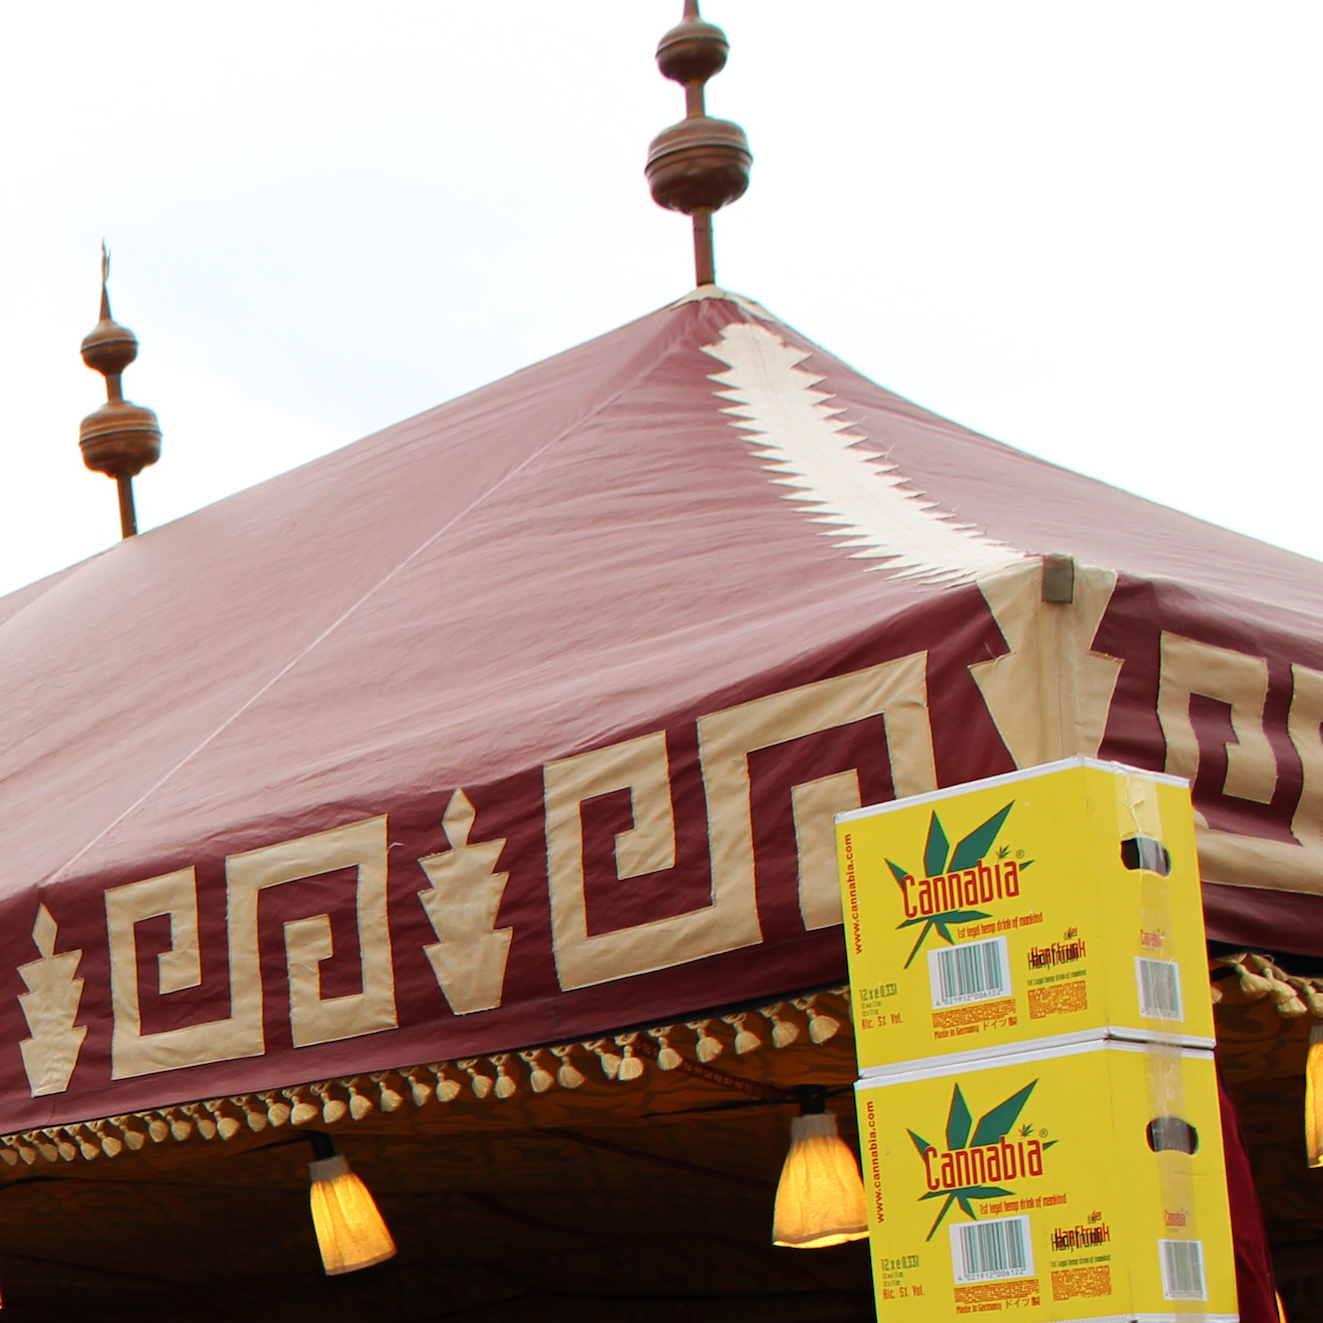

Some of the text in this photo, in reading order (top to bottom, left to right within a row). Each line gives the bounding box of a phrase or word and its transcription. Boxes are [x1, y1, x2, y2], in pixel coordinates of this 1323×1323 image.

[845, 833, 863, 955] www.cannabia.com
[902, 858, 1020, 919] Cannabia
[867, 1101, 884, 1223] www.cannabia.com
[925, 1136, 1043, 1191] Cannabia
[990, 1202, 1003, 1215] legal
[1004, 1199, 1018, 1212] hemp
[1020, 1197, 1034, 1210] drink
[1036, 1196, 1041, 1209] of
[1043, 1193, 1067, 1206] mankind
